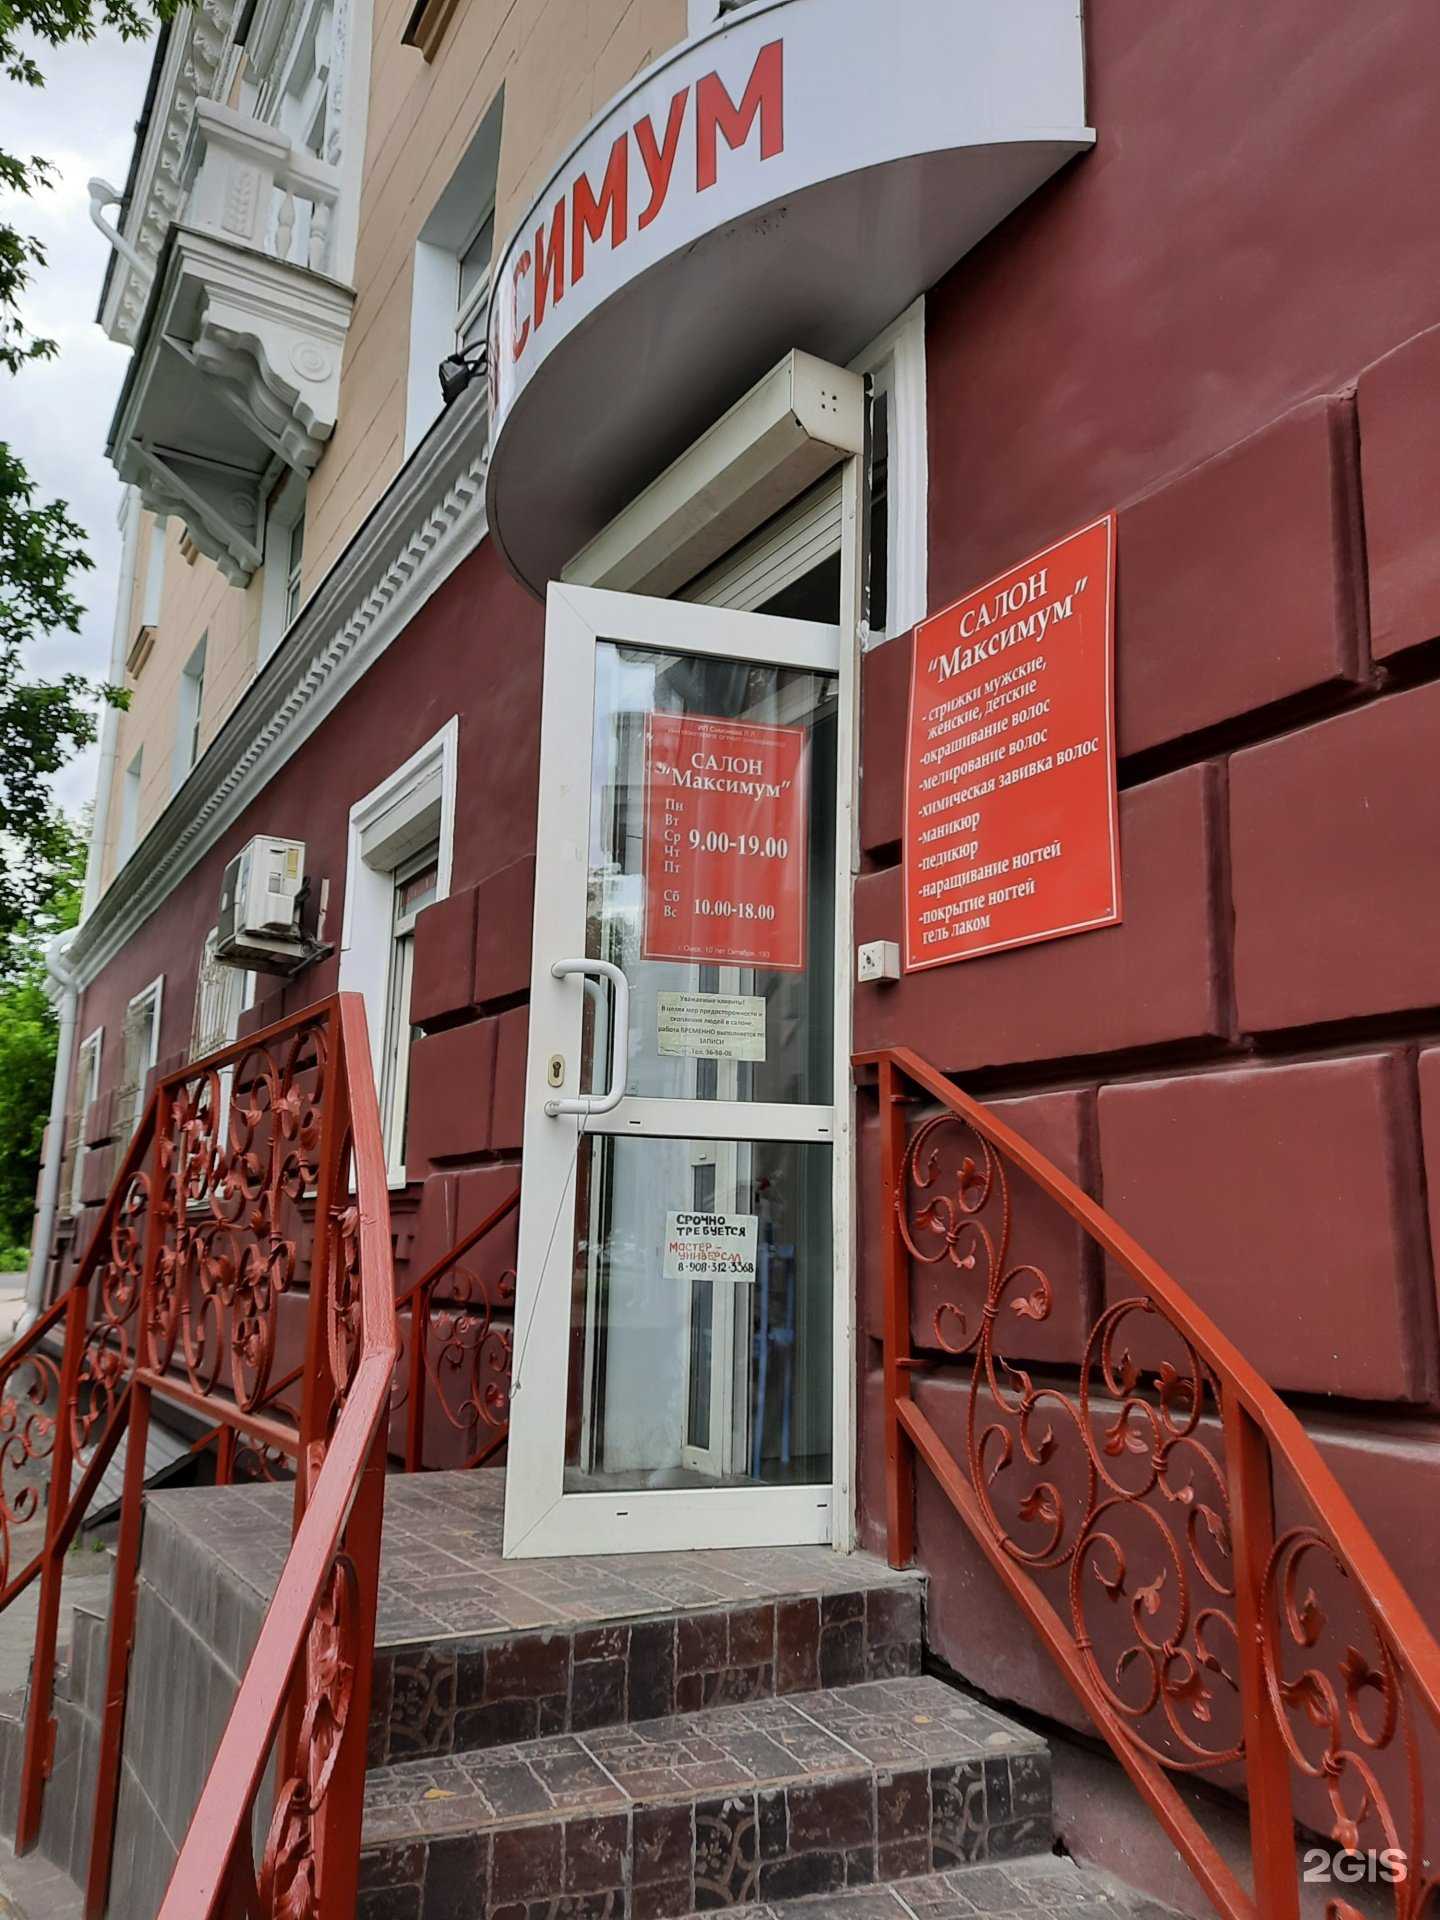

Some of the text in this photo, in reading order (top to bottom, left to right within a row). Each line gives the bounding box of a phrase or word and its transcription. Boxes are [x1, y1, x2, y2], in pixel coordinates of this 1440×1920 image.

[960, 568, 1048, 638] САЛОН
[928, 687, 981, 722] стрижки
[984, 655, 1047, 696] мужские,
[927, 679, 1037, 740] женские, детские
[920, 699, 1051, 765] -окрашивание волос
[691, 752, 763, 776] САЛОН
[918, 728, 1048, 791] -мелирование волос
[918, 737, 1099, 818] -химическая завивка волос
[665, 798, 684, 812] Пн
[665, 813, 680, 826] Вт
[918, 812, 980, 844] -маникюр
[664, 829, 788, 859] Ср 9.00-19.00
[664, 845, 680, 858] Чт
[918, 840, 979, 870] -педикюр
[664, 860, 680, 873] Пт
[918, 840, 1062, 899] -наращивание ногтей
[663, 888, 680, 902] Сб
[663, 898, 775, 921] Вс 10.00-18.00
[918, 877, 1036, 925] -покрытие ногтей
[922, 914, 991, 945] гель лаком
[676, 1214, 726, 1226] СРОЧНО
[676, 1226, 746, 1237] ТРЕБУЕТСЯ
